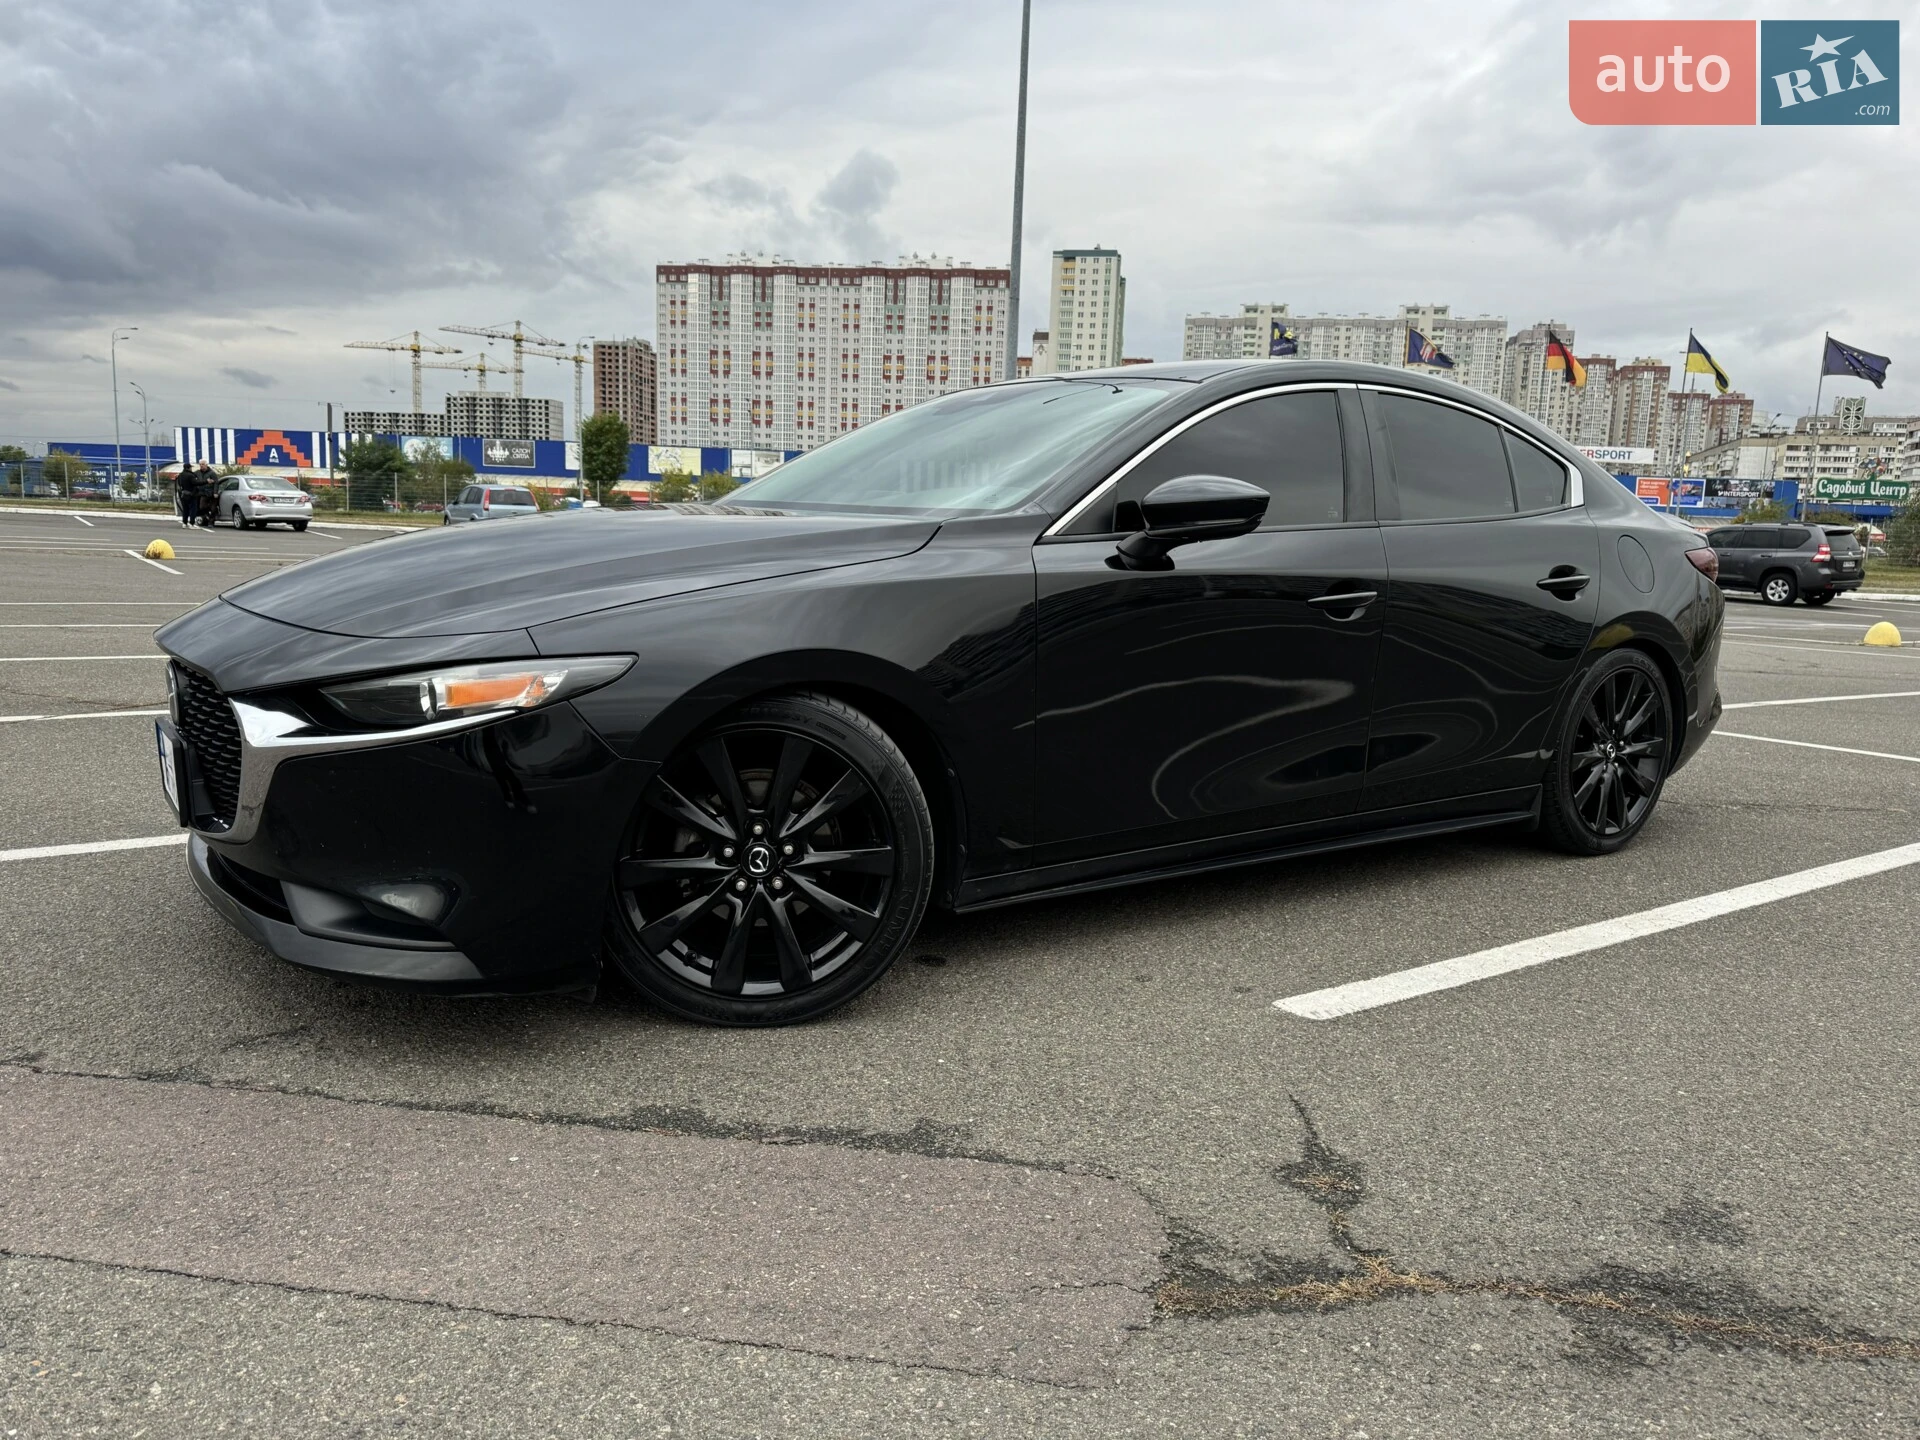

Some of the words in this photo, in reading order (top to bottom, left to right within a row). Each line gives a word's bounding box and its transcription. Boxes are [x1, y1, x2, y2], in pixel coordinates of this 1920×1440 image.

[511, 447, 531, 455] САЛОН
[1818, 479, 1866, 498] Садовий
[1870, 480, 1908, 499] Центр
[1723, 490, 1760, 498] INTERSPORT
